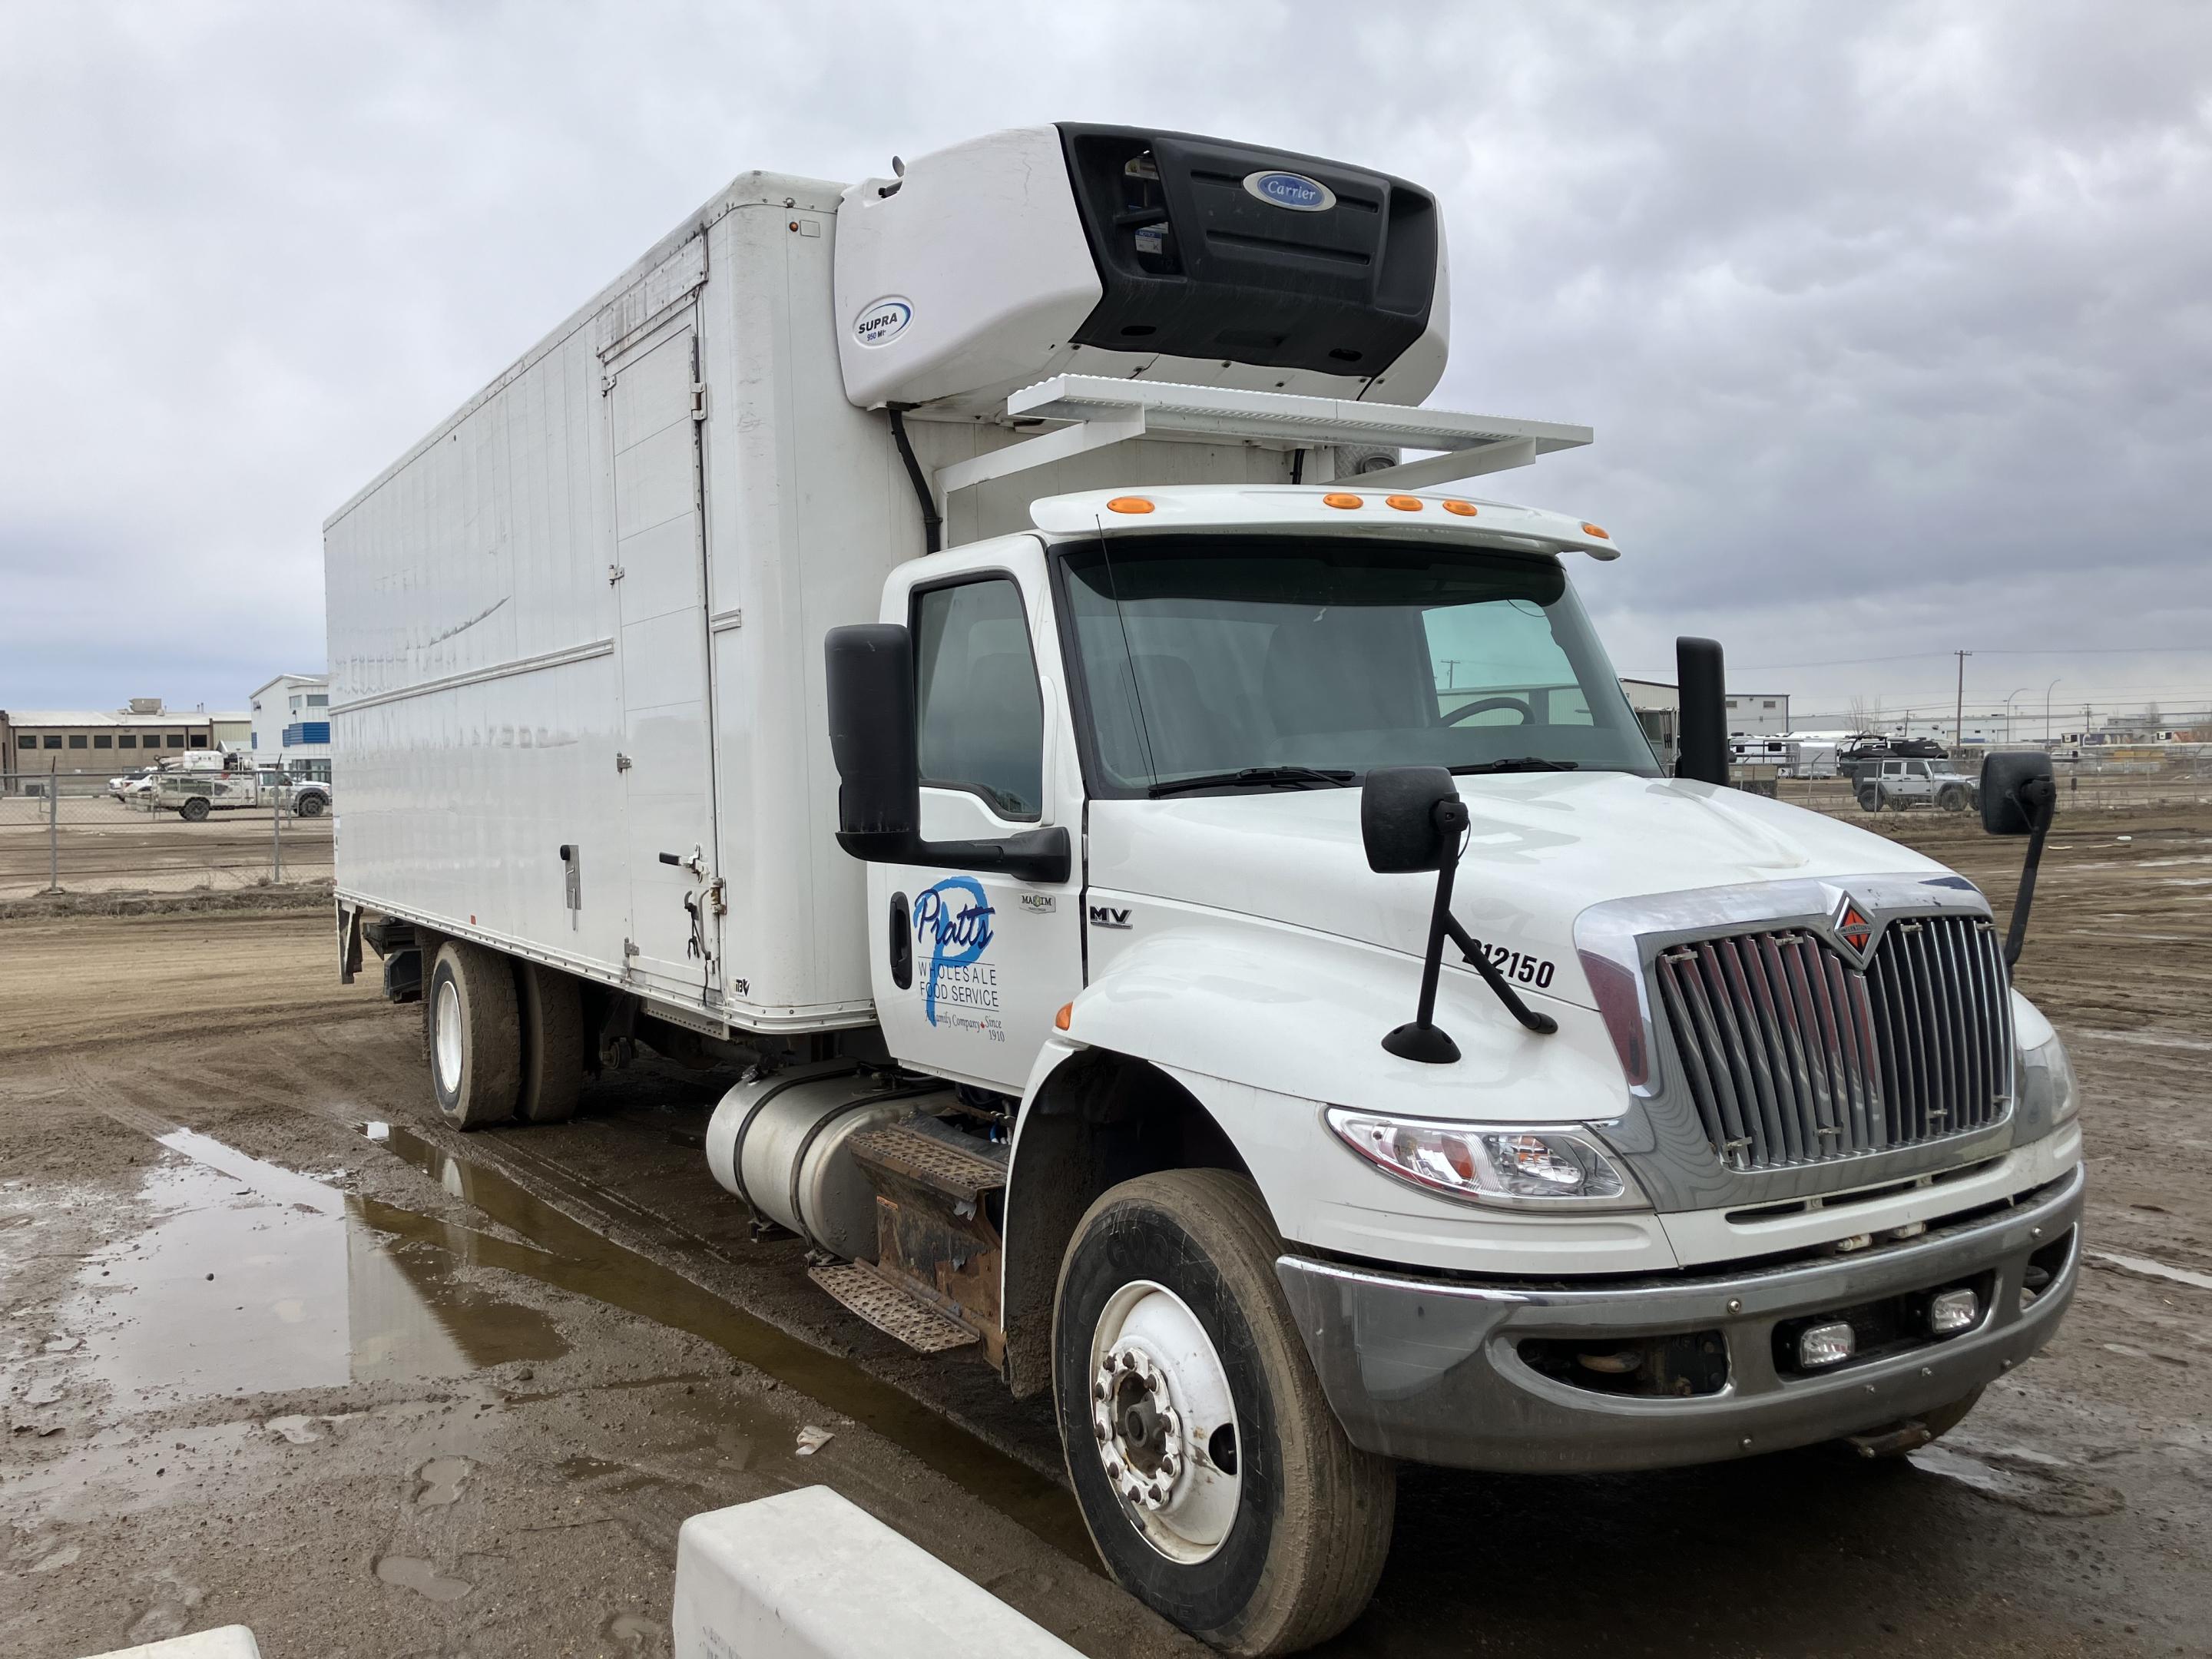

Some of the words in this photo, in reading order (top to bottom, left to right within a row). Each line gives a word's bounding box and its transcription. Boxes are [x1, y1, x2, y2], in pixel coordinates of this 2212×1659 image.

[1268, 180, 1316, 200] Carrier
[859, 313, 898, 334] SUPRA
[915, 889, 995, 949] Pratts
[1090, 906, 1132, 924] MV
[919, 961, 997, 985] WHOLESALE
[920, 982, 948, 999] FOOD
[952, 985, 999, 1007] SERVICE
[952, 1014, 981, 1033] Company
[985, 1015, 1002, 1029] Since
[988, 1030, 1005, 1042] 1910
